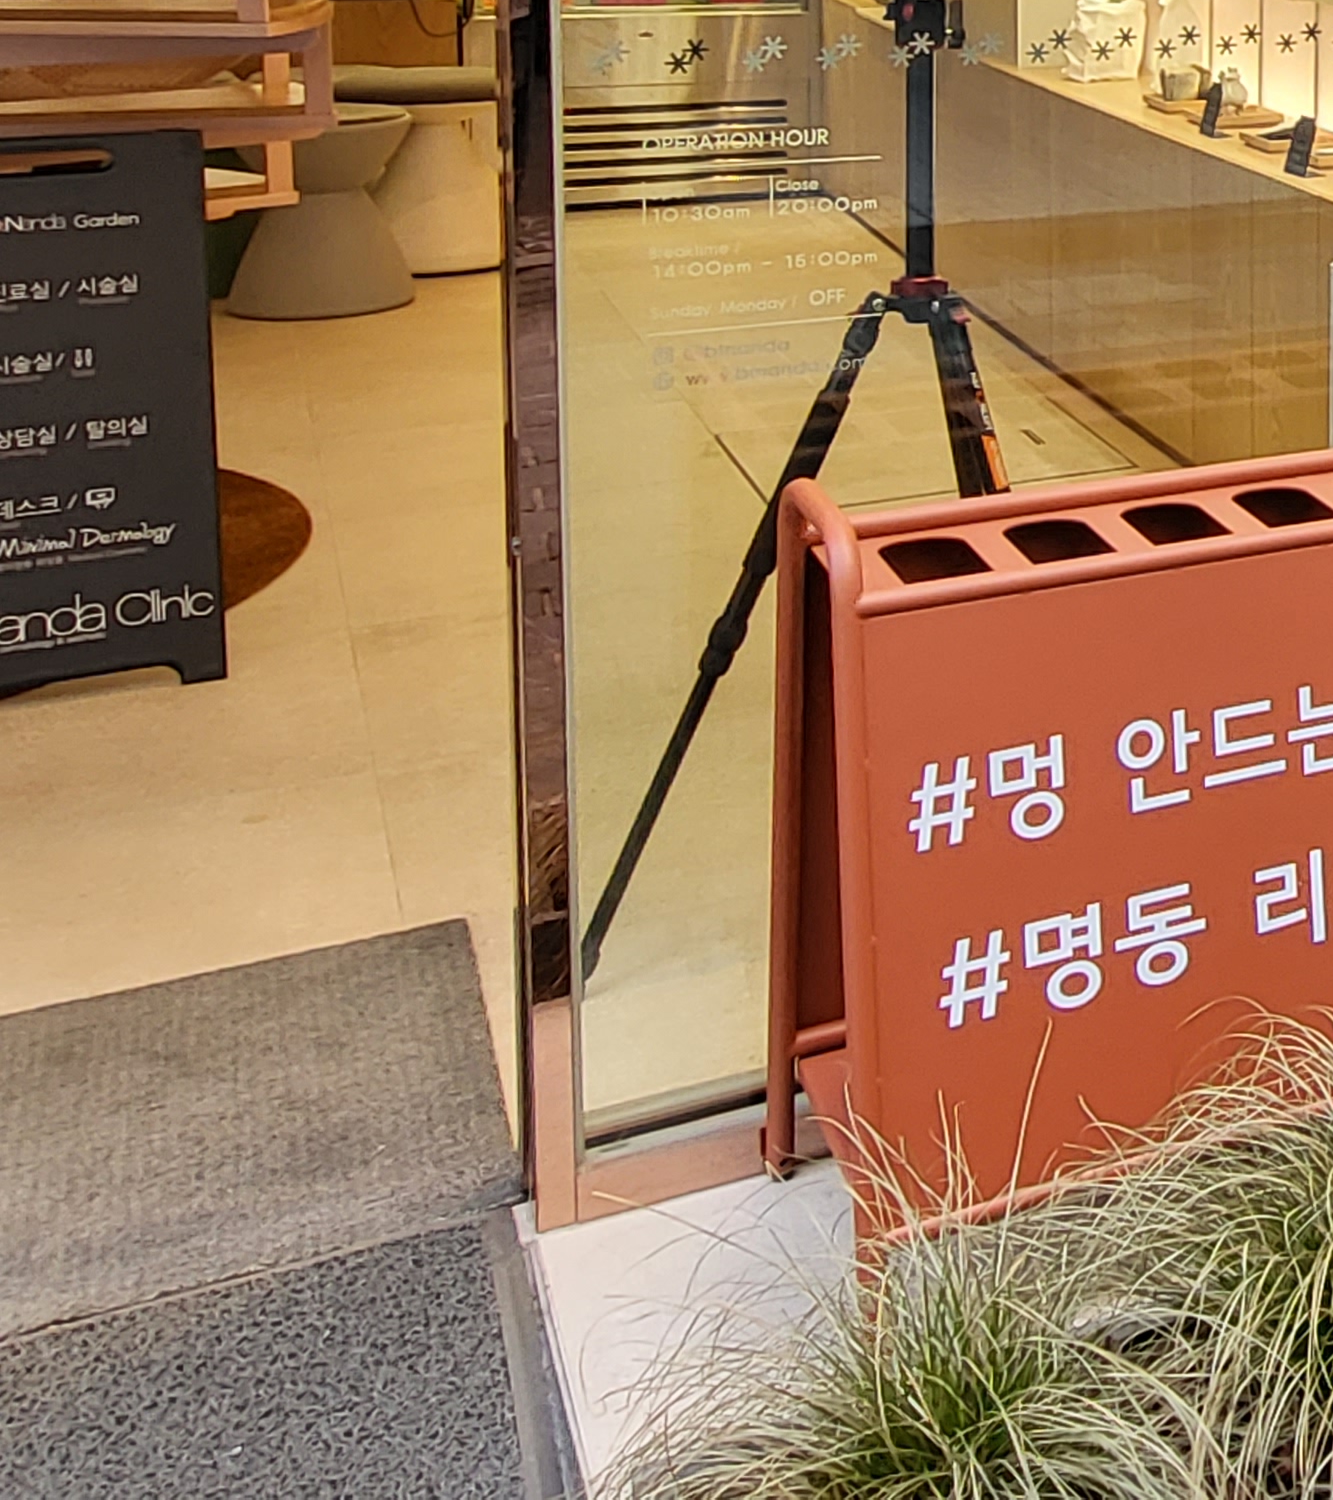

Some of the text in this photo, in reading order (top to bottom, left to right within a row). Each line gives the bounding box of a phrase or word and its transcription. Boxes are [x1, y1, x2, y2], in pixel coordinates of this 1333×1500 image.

[641, 128, 829, 152] OPERATION HOUR
[775, 178, 819, 193] Close
[73, 212, 140, 229] Garden
[652, 197, 878, 223] 10:30am 20:00pm
[77, 274, 138, 296] 시술실
[808, 288, 847, 307] OFF
[86, 415, 148, 440] 탈의실
[115, 584, 215, 626] Clinic
[907, 733, 1066, 852] #멍
[938, 882, 1207, 1028] #명동
